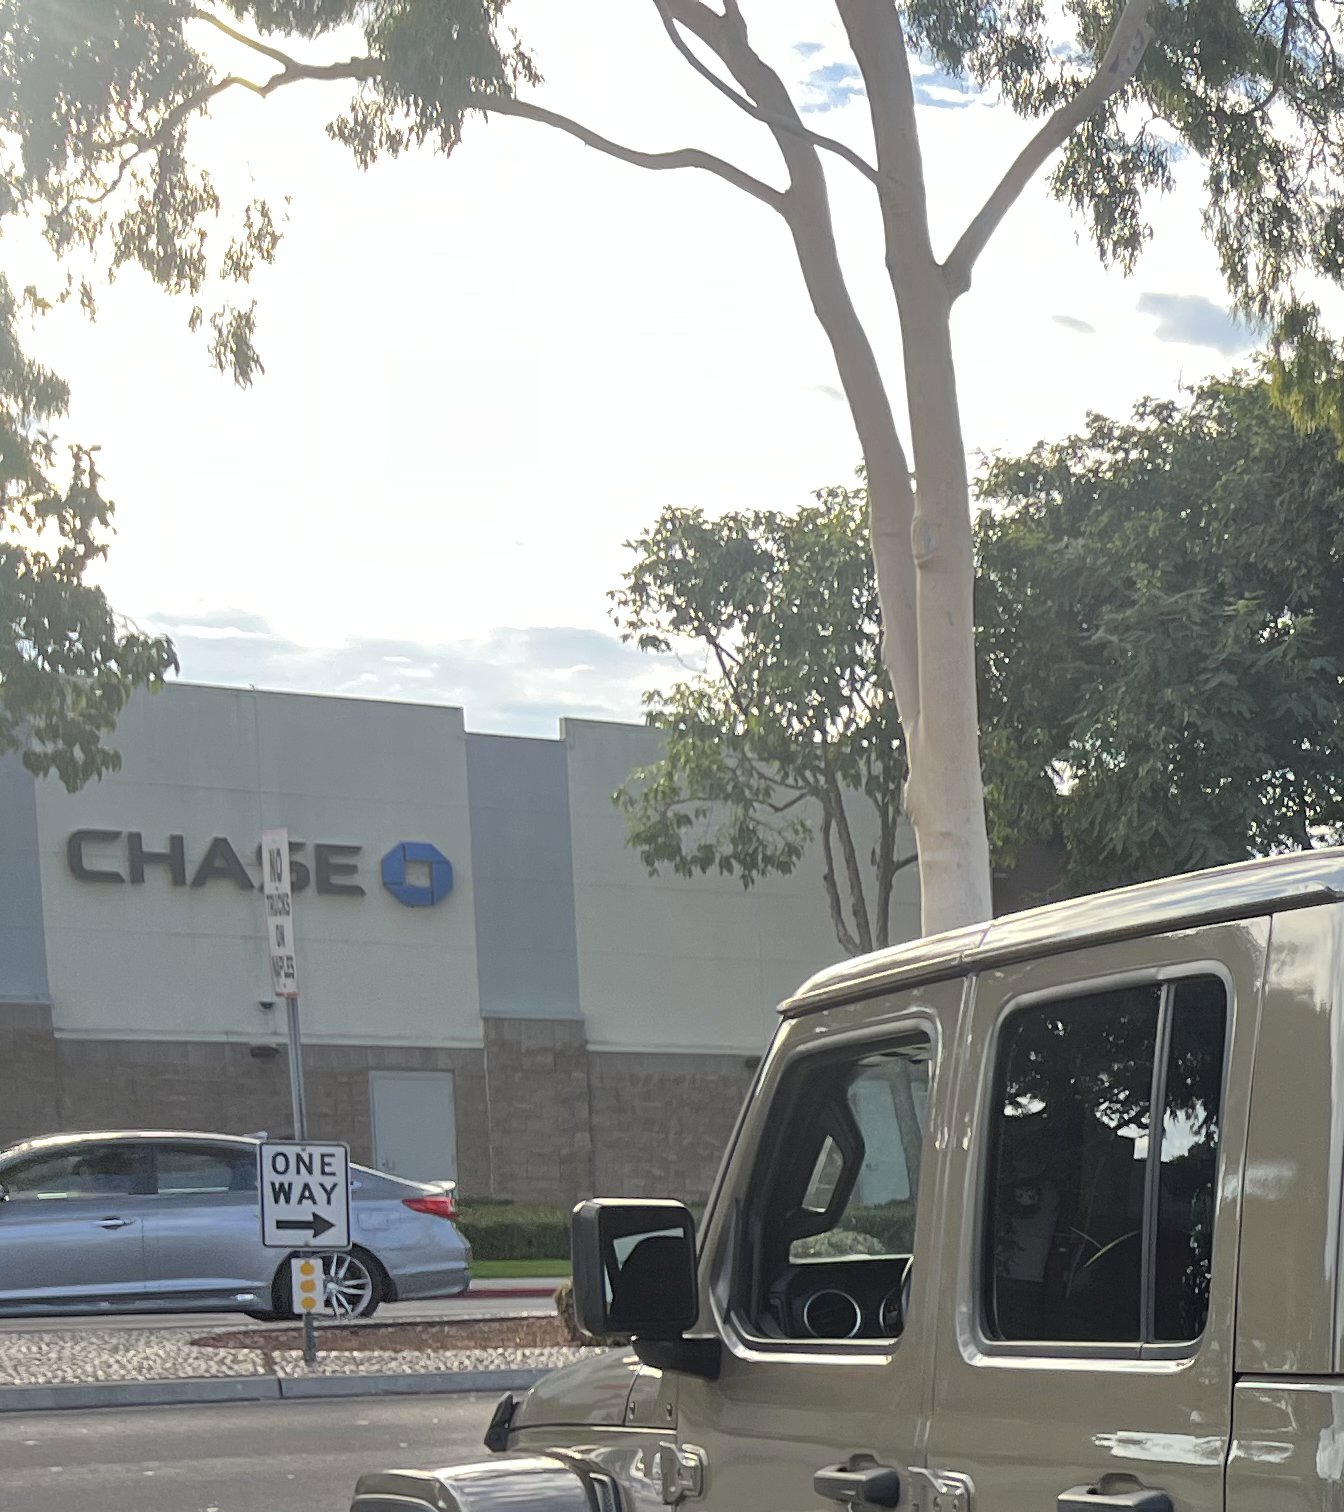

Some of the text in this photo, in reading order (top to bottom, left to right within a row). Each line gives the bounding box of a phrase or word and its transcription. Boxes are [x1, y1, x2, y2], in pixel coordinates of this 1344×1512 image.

[67, 828, 366, 897] CHASE
[268, 847, 283, 884] NO
[266, 892, 290, 917] TRUCKS
[275, 924, 286, 948] ON
[271, 1152, 337, 1176] ONE
[270, 1182, 338, 1206] WAY
